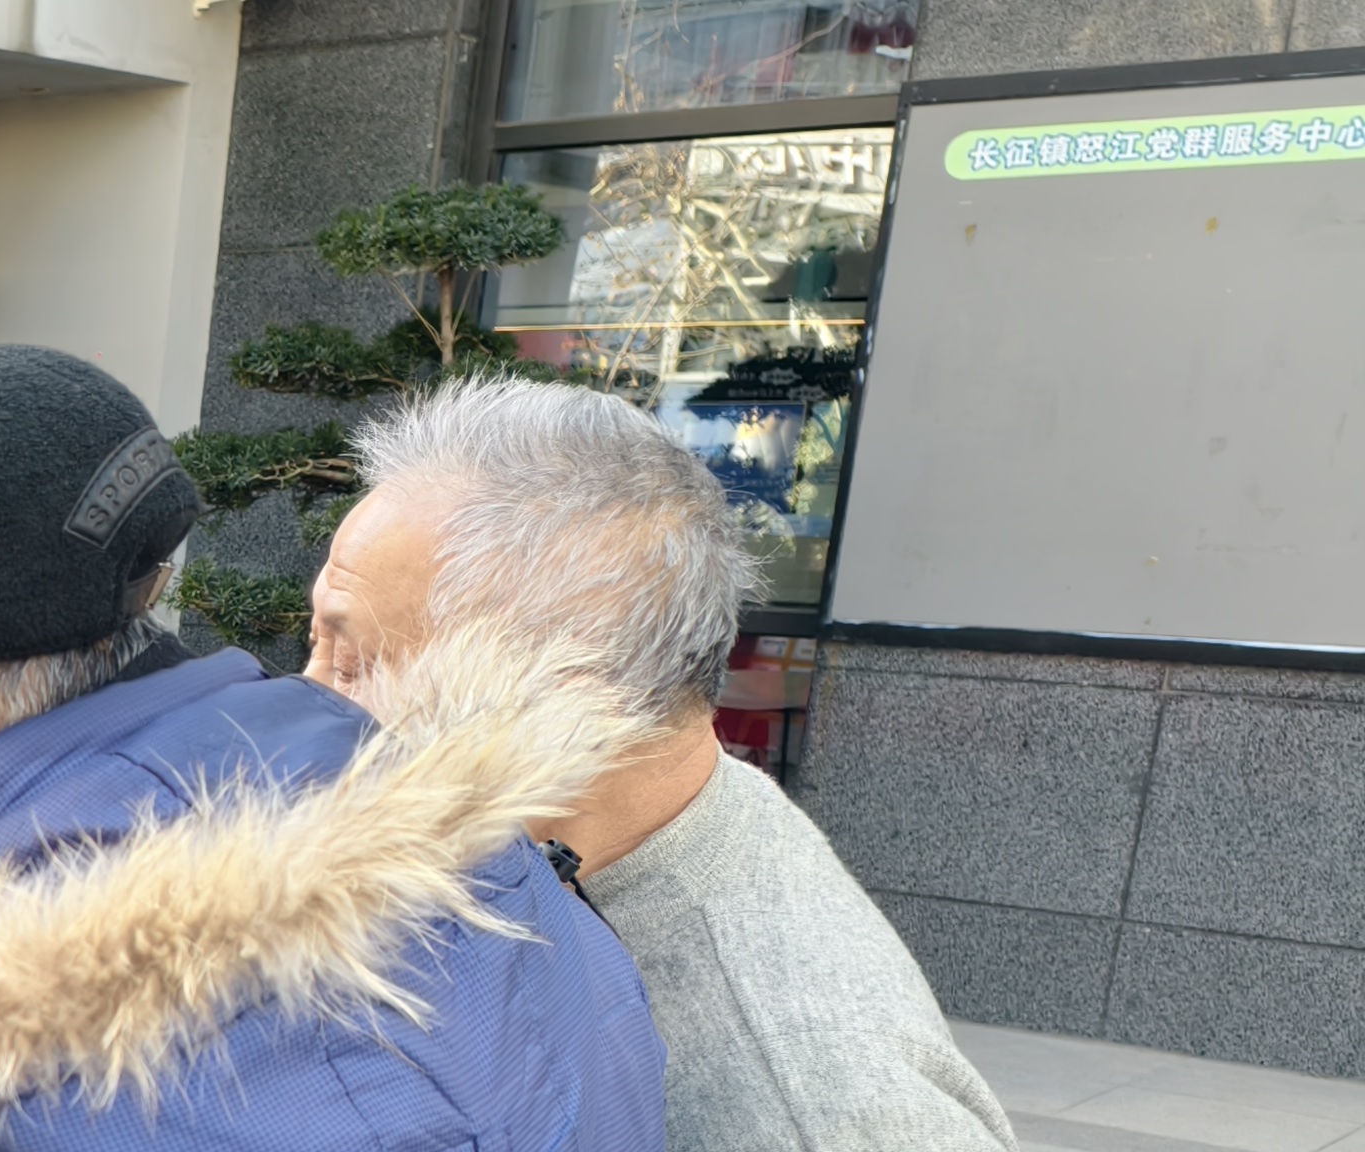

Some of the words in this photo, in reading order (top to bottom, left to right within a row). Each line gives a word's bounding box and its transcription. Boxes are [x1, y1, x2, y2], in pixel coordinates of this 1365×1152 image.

[969, 115, 1365, 172] 长征镇怒江党群服务中心
